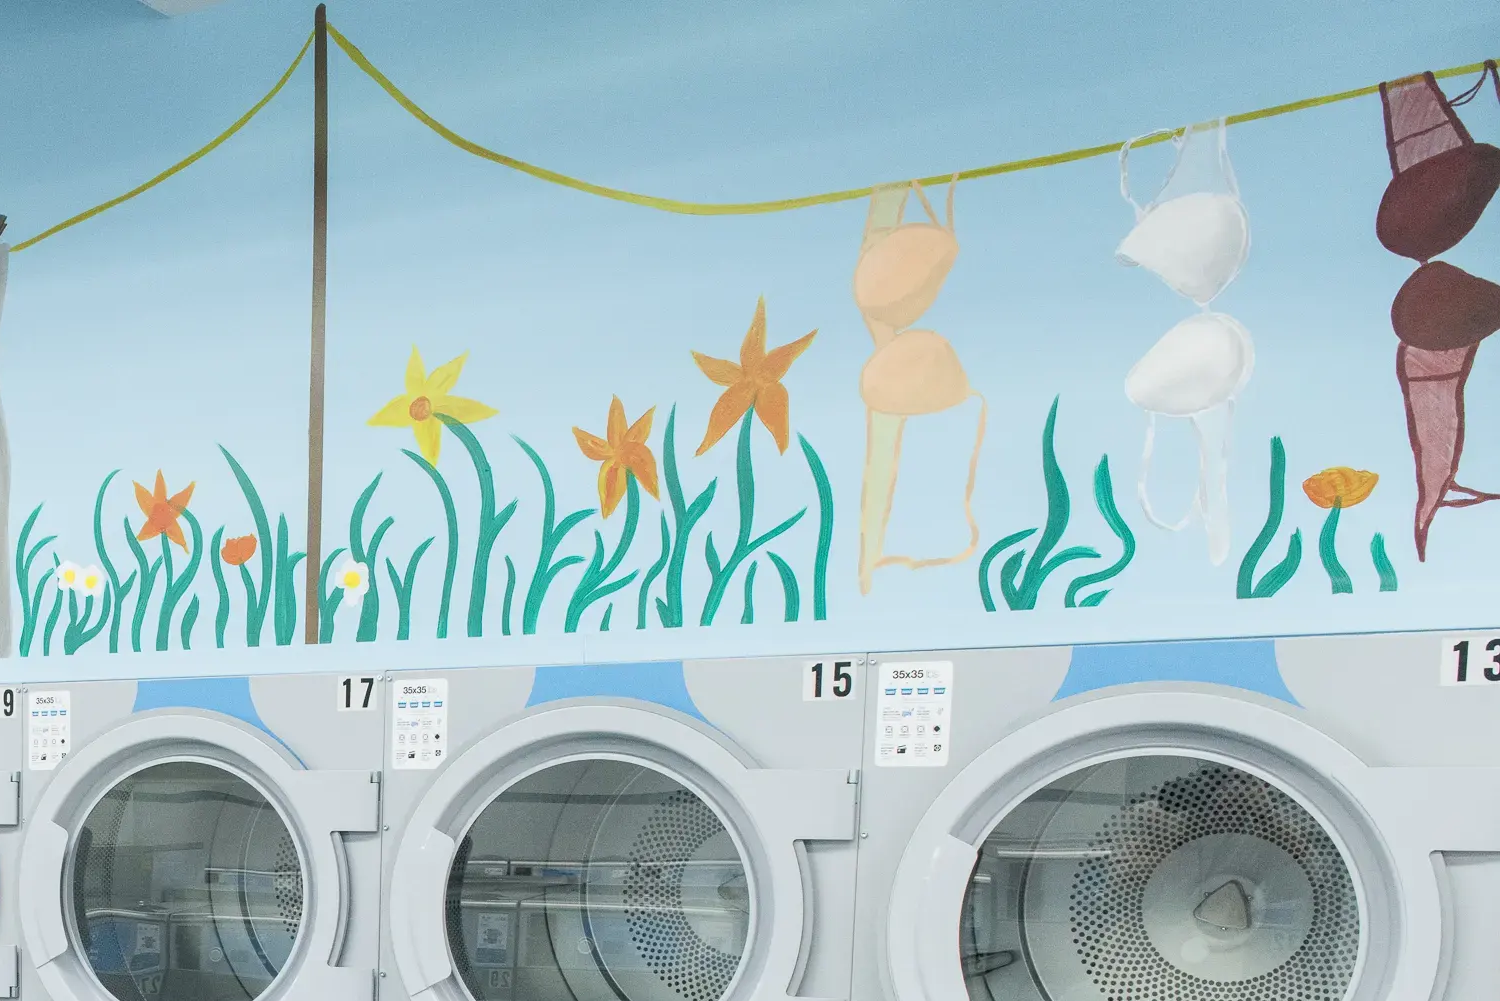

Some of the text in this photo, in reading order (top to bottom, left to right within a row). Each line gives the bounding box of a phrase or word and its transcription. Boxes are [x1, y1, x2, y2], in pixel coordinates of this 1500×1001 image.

[892, 670, 924, 679] 35x35
[1452, 639, 1500, 682] 13
[342, 678, 374, 708] 17
[403, 686, 427, 694] 35x35
[811, 661, 852, 697] 15
